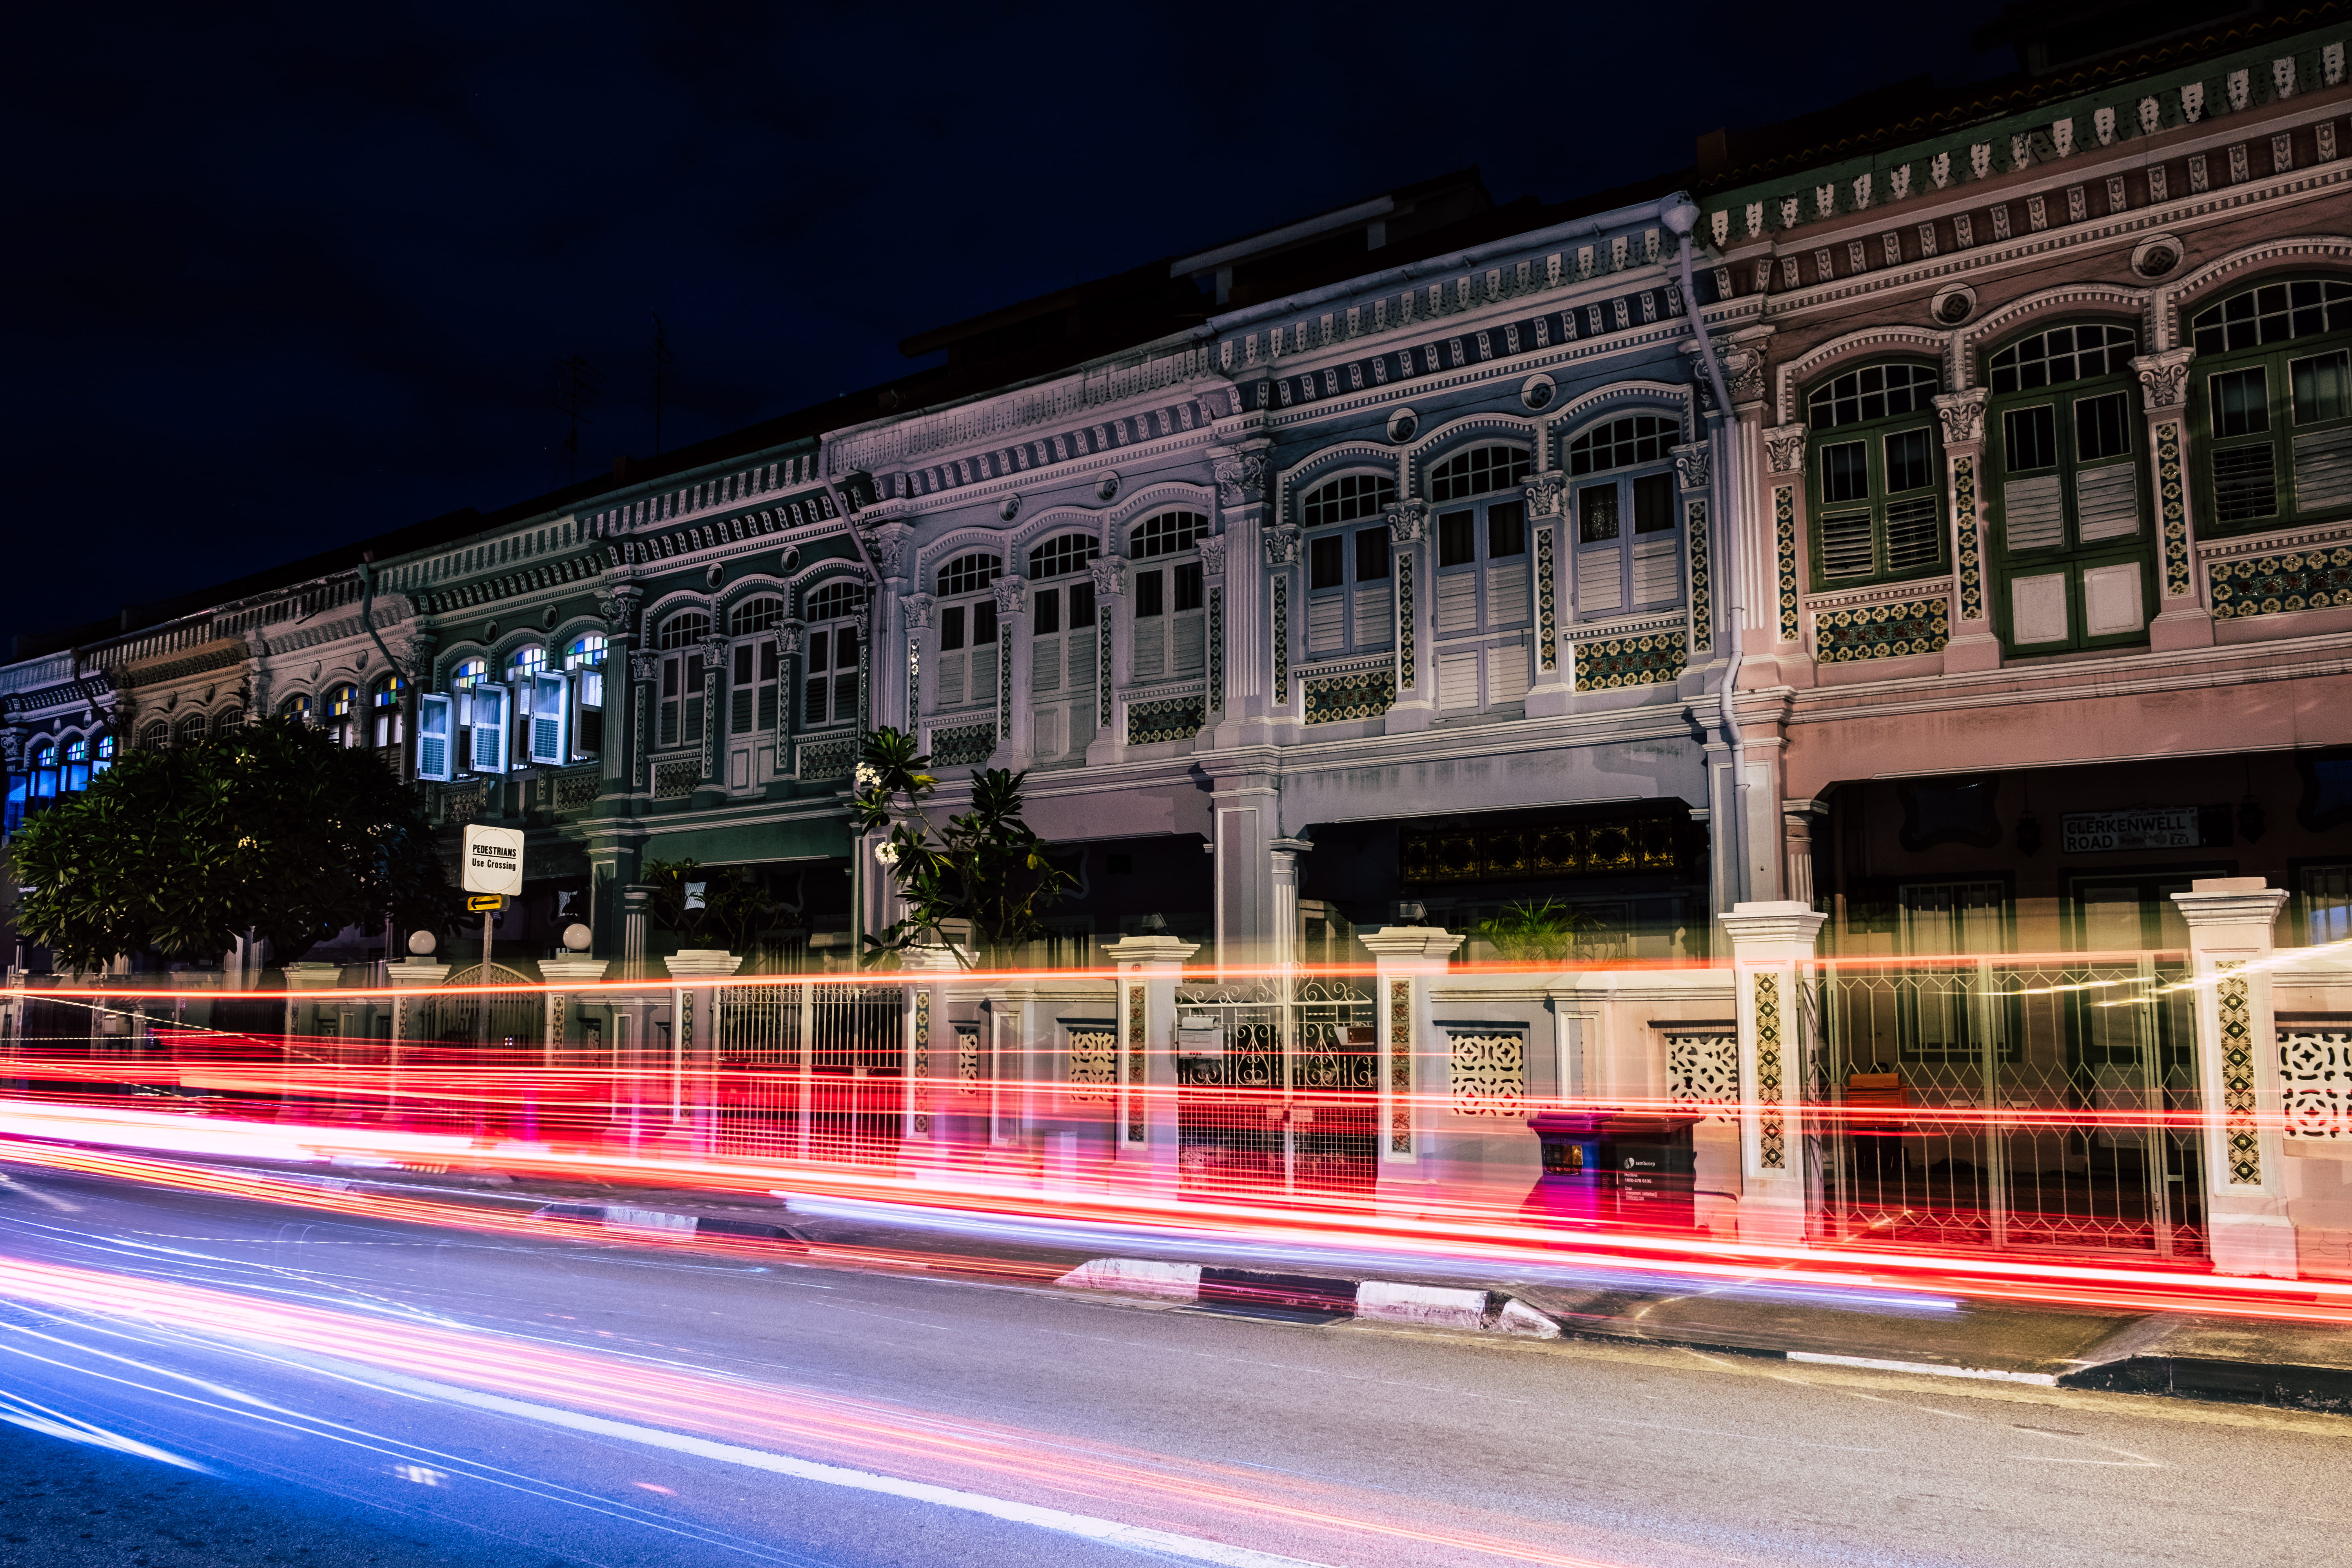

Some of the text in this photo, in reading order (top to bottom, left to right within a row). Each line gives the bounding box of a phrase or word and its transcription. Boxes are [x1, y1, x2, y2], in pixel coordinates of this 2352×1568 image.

[2067, 816, 2186, 834] CLERKENWELL
[2067, 835, 2113, 850] ROAD
[473, 844, 517, 857] PEDESTRIANS
[472, 858, 516, 871] Use Crossing
